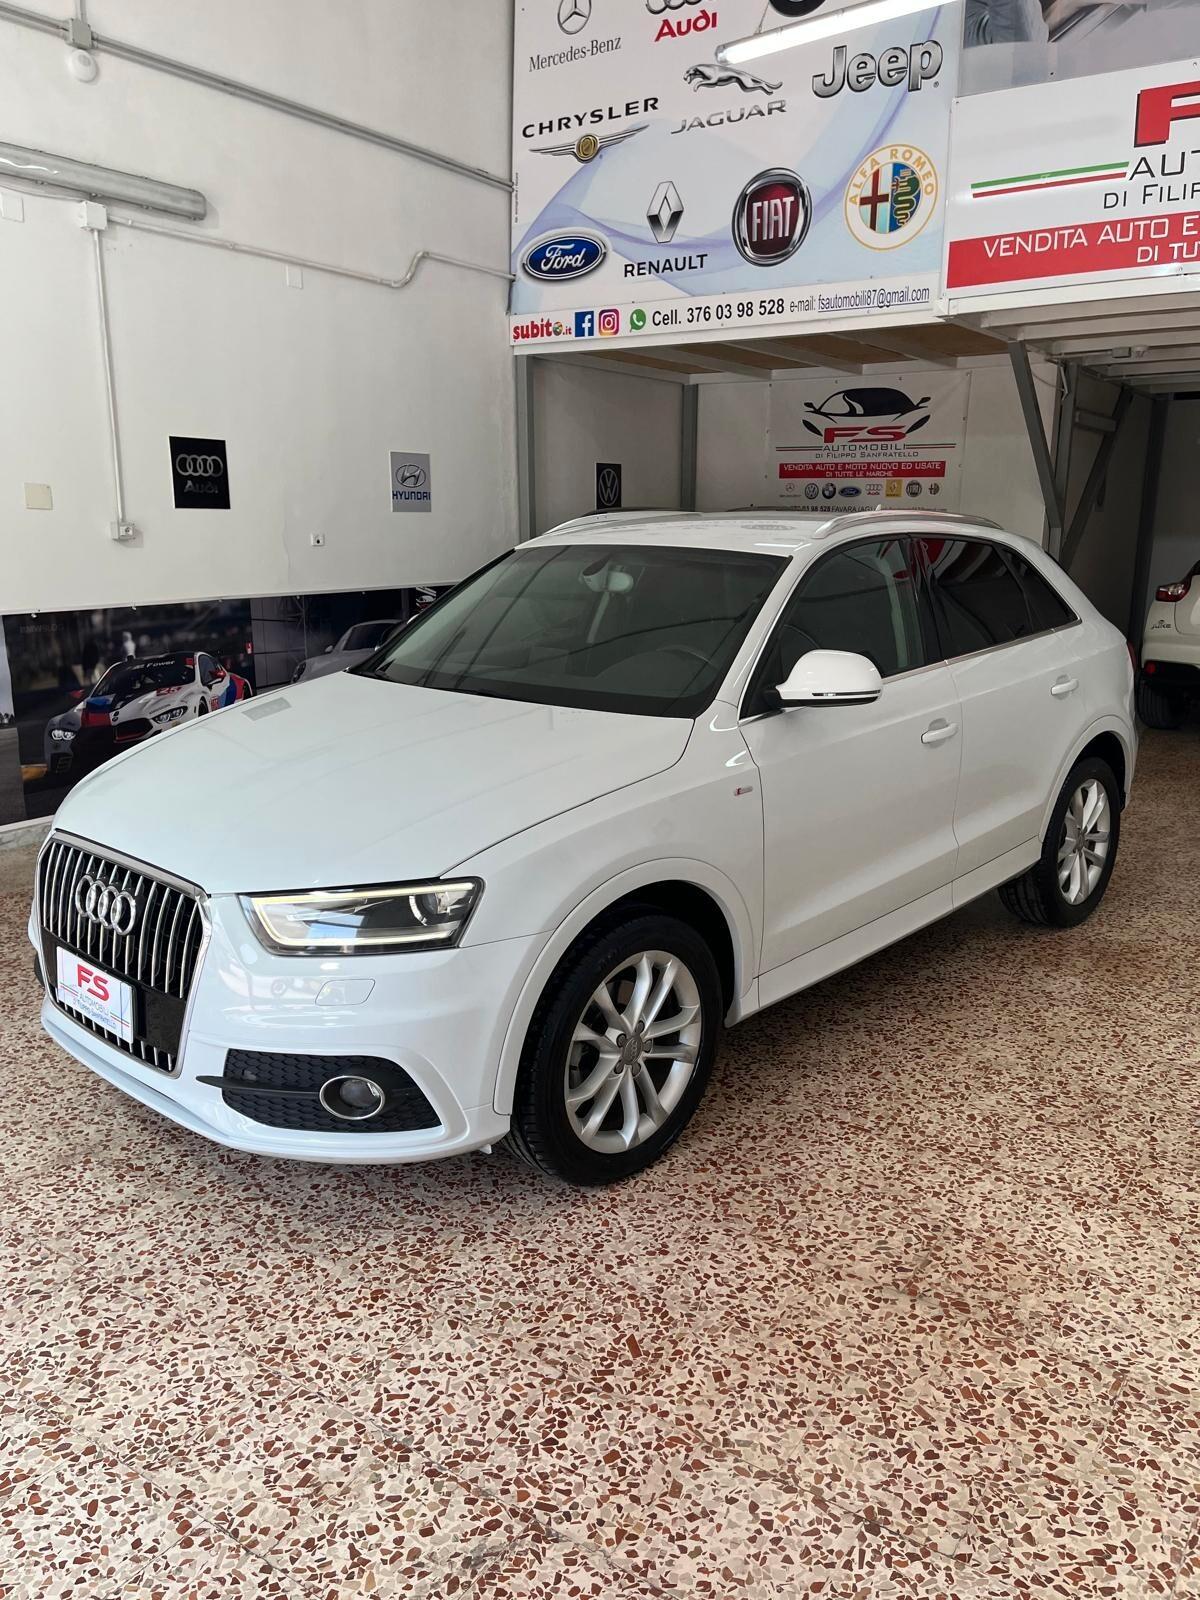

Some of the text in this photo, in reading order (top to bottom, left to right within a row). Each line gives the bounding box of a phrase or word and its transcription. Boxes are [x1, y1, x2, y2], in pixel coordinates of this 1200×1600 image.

[654, 9, 718, 43] Audi
[528, 36, 622, 73] Mercedes-Benz
[812, 40, 943, 99] Jeep
[522, 97, 659, 139] CHRYSLER
[670, 100, 787, 135] JAGUAR
[849, 148, 935, 205] ALFA ROMEO
[1103, 190, 1127, 209] DI
[751, 195, 795, 242] FIAT
[983, 214, 1199, 259] VENDITA AUTO E
[1136, 240, 1200, 263] DI TU
[540, 243, 586, 272] Ford
[623, 253, 708, 278] RENAULT
[513, 317, 572, 340] subito.it
[652, 309, 682, 326] Cell.
[686, 306, 711, 323] 376
[715, 304, 732, 320] 03
[737, 301, 754, 318] 98
[759, 298, 785, 316] 528
[789, 296, 816, 313] e-mail:
[818, 286, 930, 312] fsautomobili87@gmail.com
[822, 443, 907, 452] AUTOMOBILI
[823, 425, 907, 443] FS
[783, 463, 813, 471] VENDITA
[901, 462, 912, 470] ED
[184, 480, 219, 494] Audi
[392, 490, 431, 501] HYUNDAI
[77, 963, 110, 1002] FS
